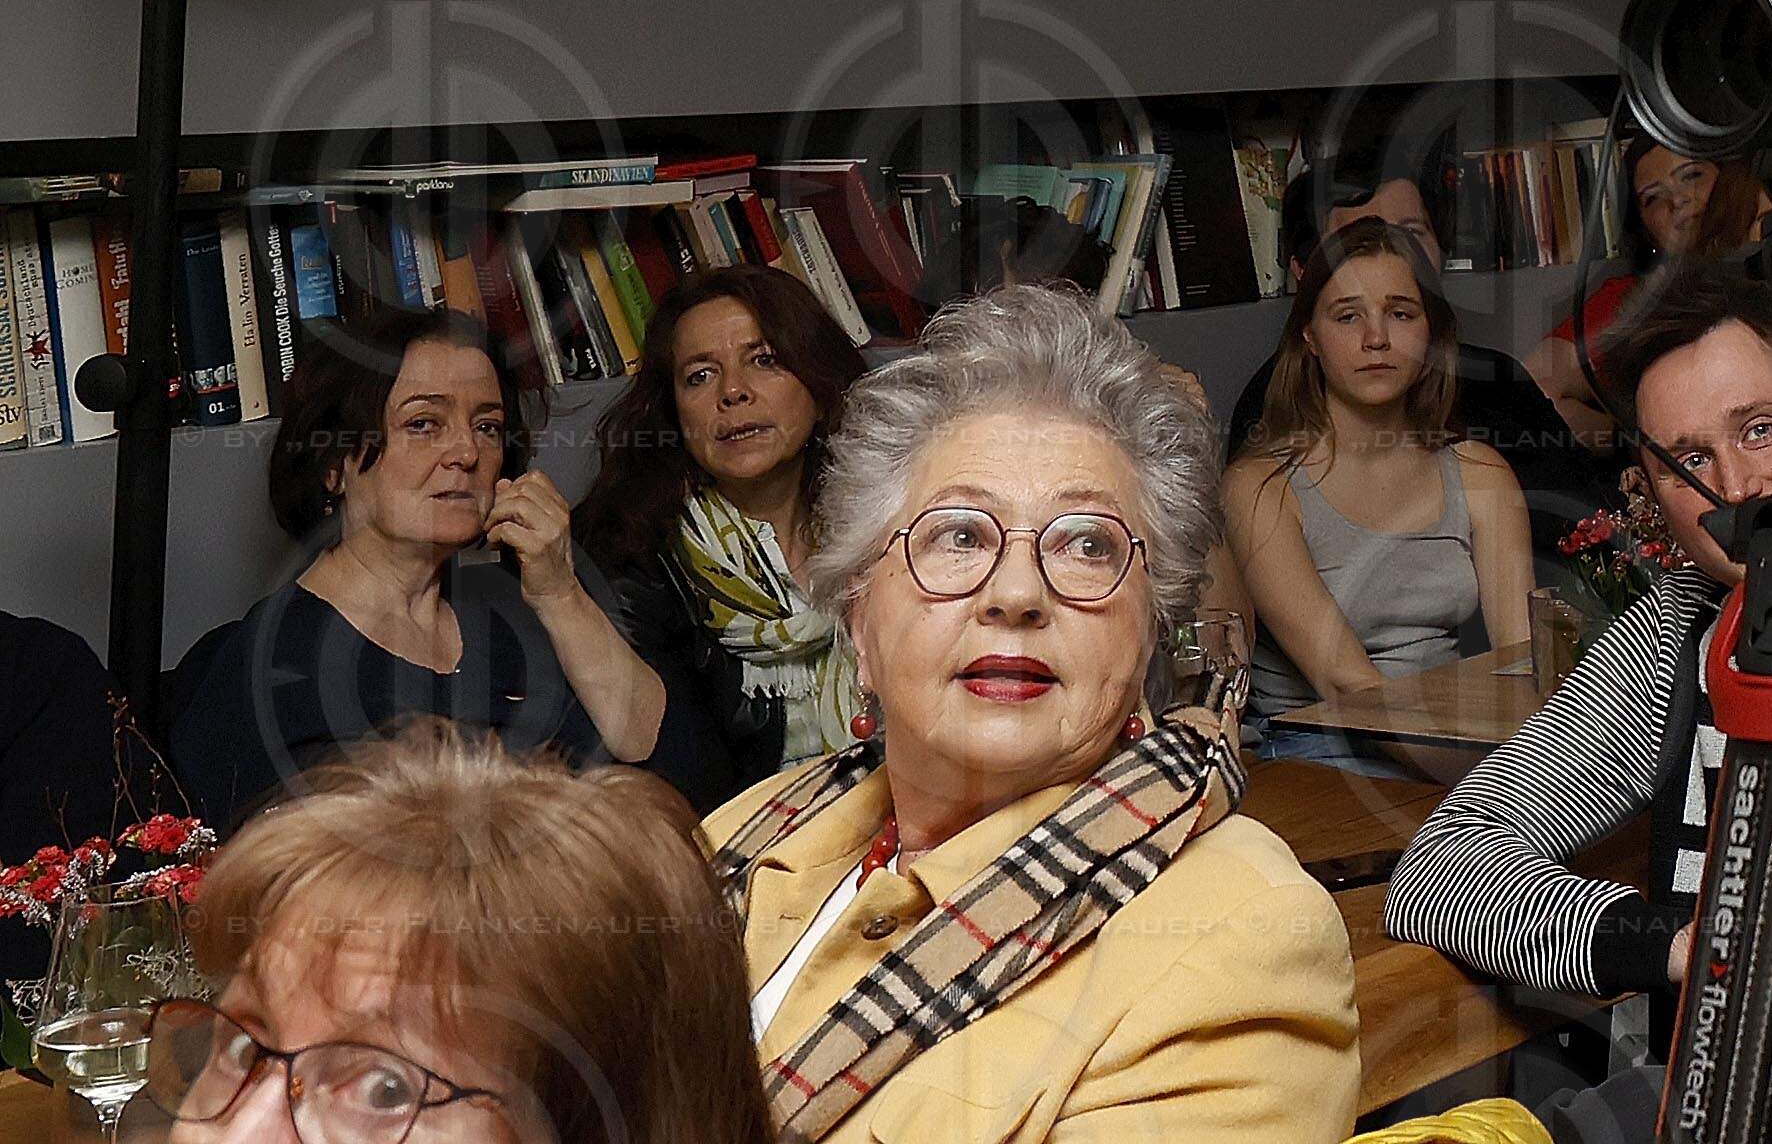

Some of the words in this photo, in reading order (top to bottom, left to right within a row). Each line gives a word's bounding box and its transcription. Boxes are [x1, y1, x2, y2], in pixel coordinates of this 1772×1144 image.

[571, 167, 650, 185] SKANDINAVIEN
[236, 252, 251, 306] Verraten
[269, 258, 287, 298] Seuche
[274, 297, 289, 316] Die
[276, 315, 293, 347] COOK
[207, 401, 226, 415] 01
[1707, 762, 1760, 961] sachtler
[1678, 982, 1729, 1131] flowtech
